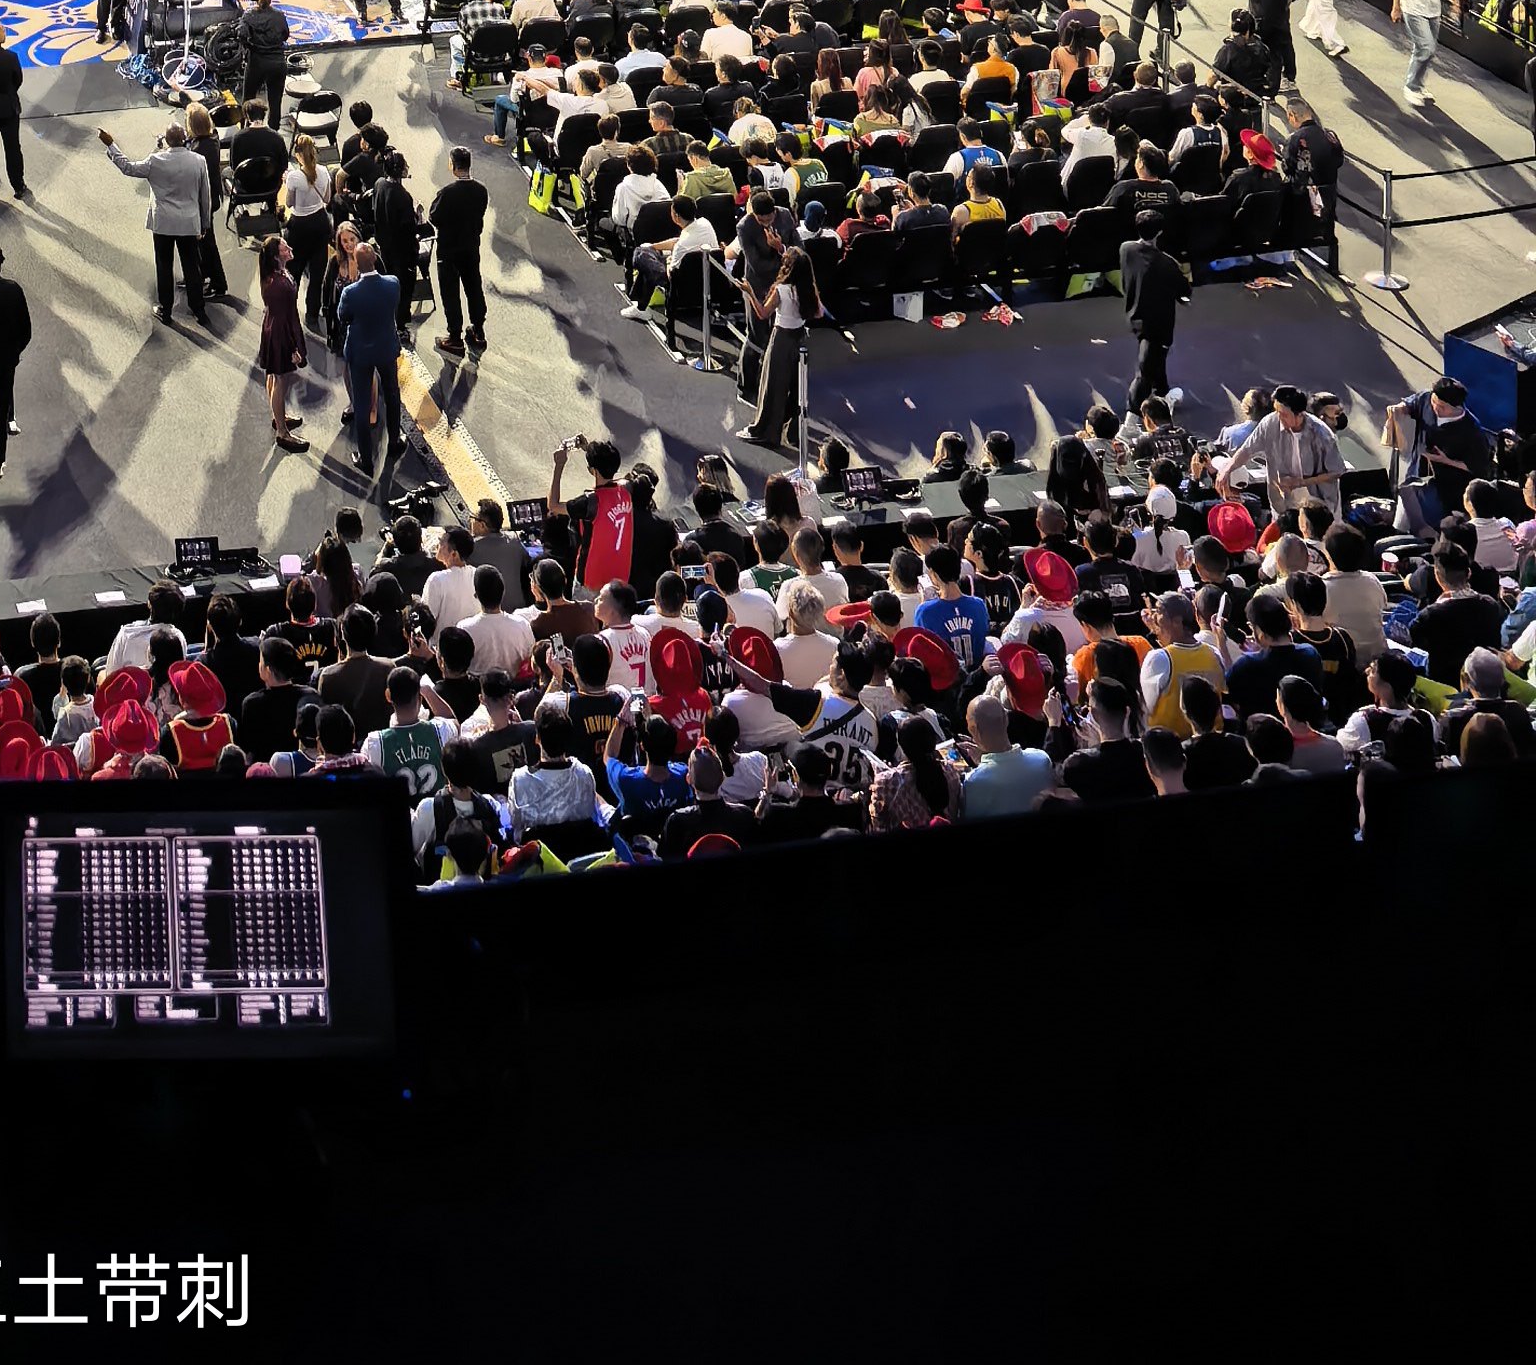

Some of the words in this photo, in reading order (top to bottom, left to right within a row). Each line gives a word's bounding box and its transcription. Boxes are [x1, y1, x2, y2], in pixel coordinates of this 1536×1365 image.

[615, 516, 626, 551] 7
[944, 616, 974, 634] IRVING
[629, 662, 646, 688] 7
[583, 714, 616, 734] IRVIN
[395, 744, 432, 765] FLAGG
